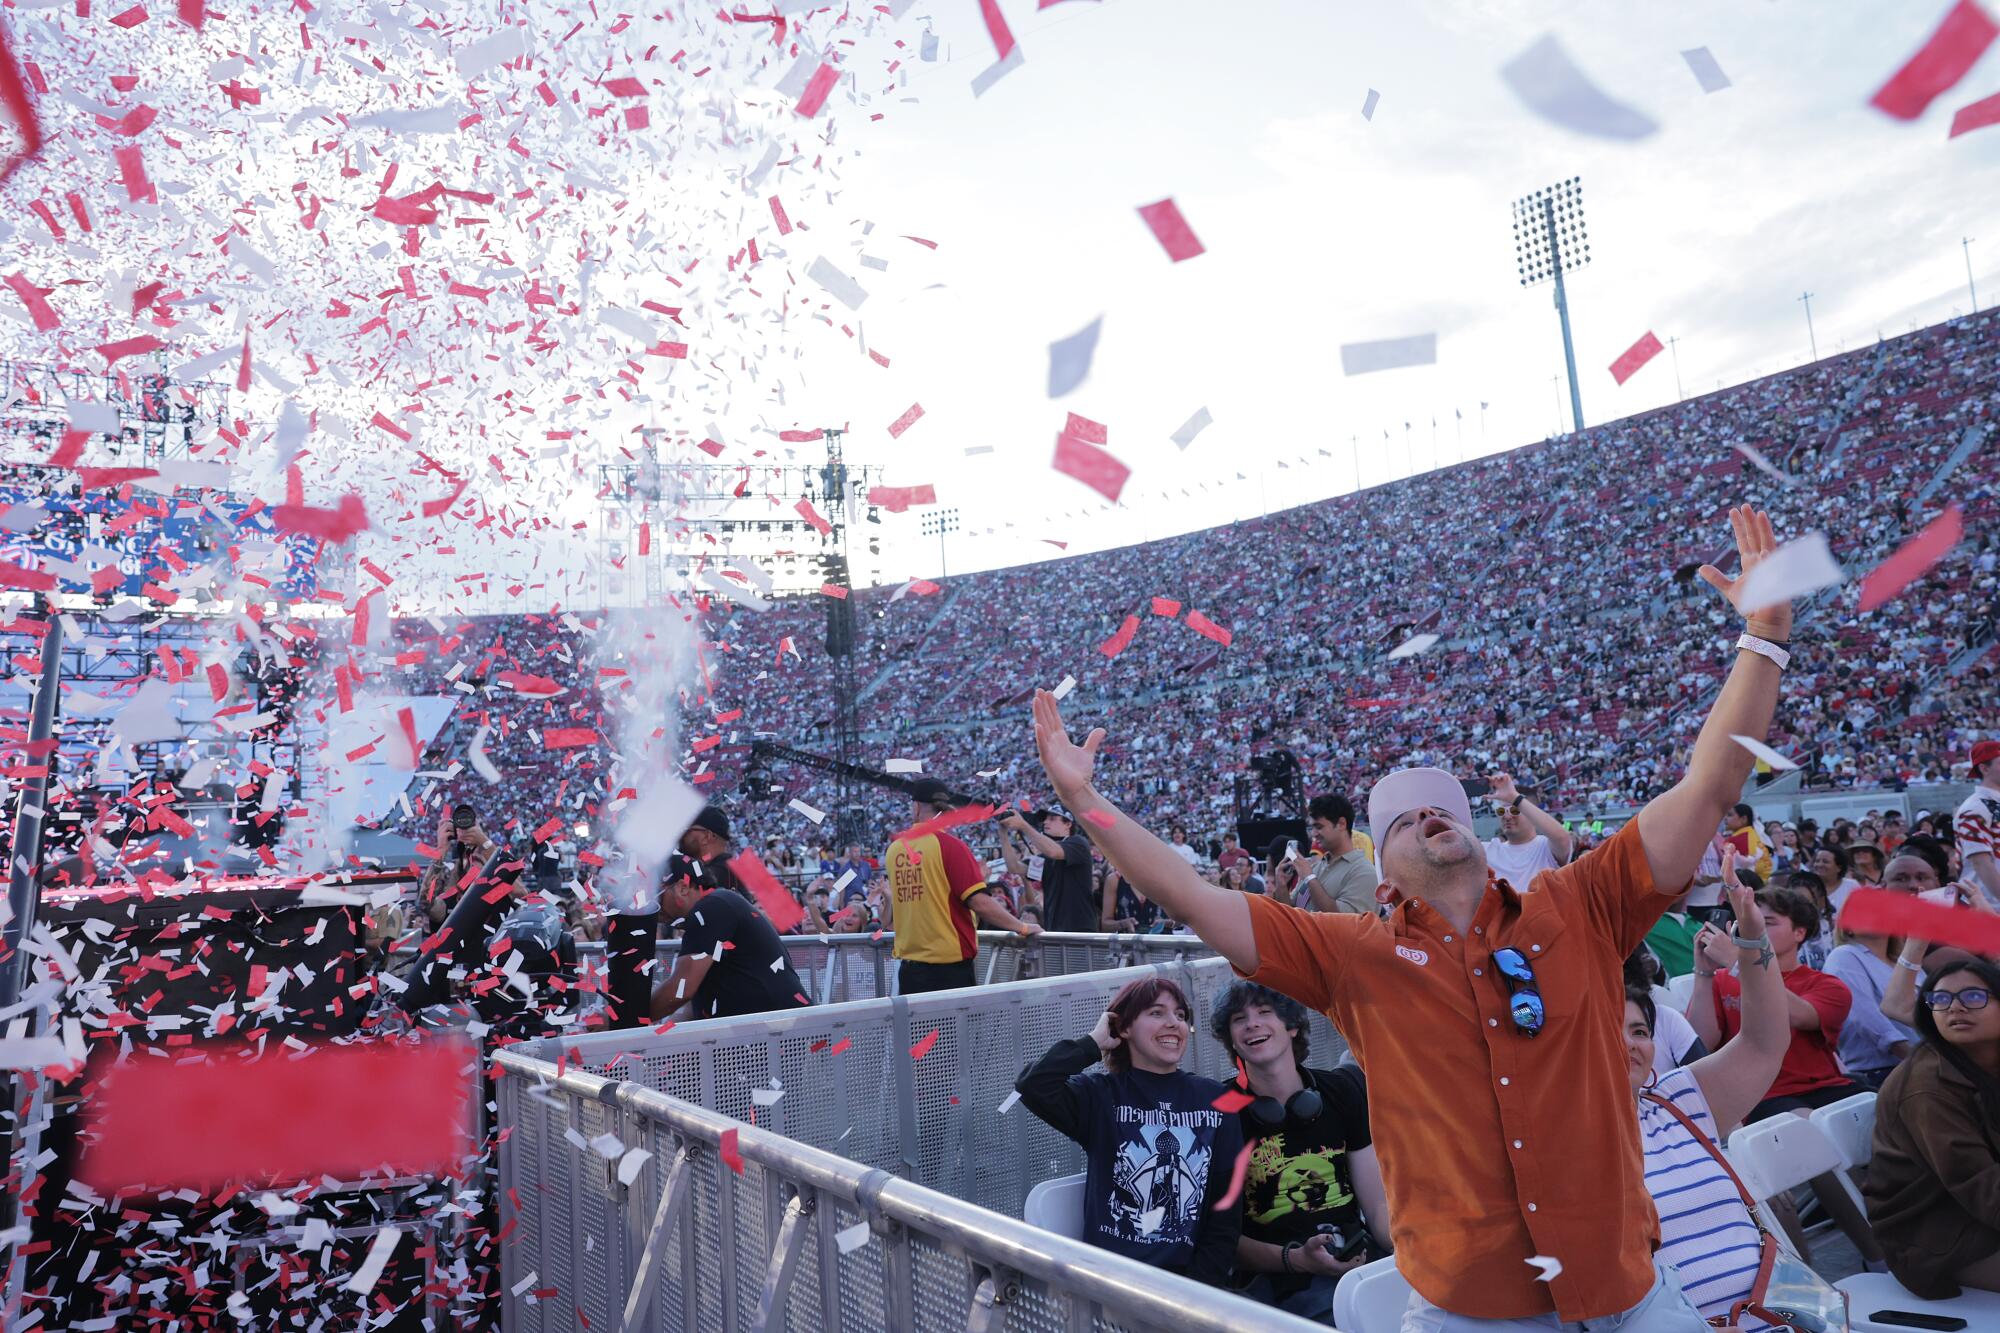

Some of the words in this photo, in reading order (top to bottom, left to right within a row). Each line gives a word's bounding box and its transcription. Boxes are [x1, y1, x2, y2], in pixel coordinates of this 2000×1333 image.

[896, 867, 922, 886] EVENT
[897, 885, 924, 903] STAFF
[1158, 1101, 1172, 1111] THE
[1114, 1105, 1167, 1126] MASHING
[1134, 1235, 1152, 1245] Rock
